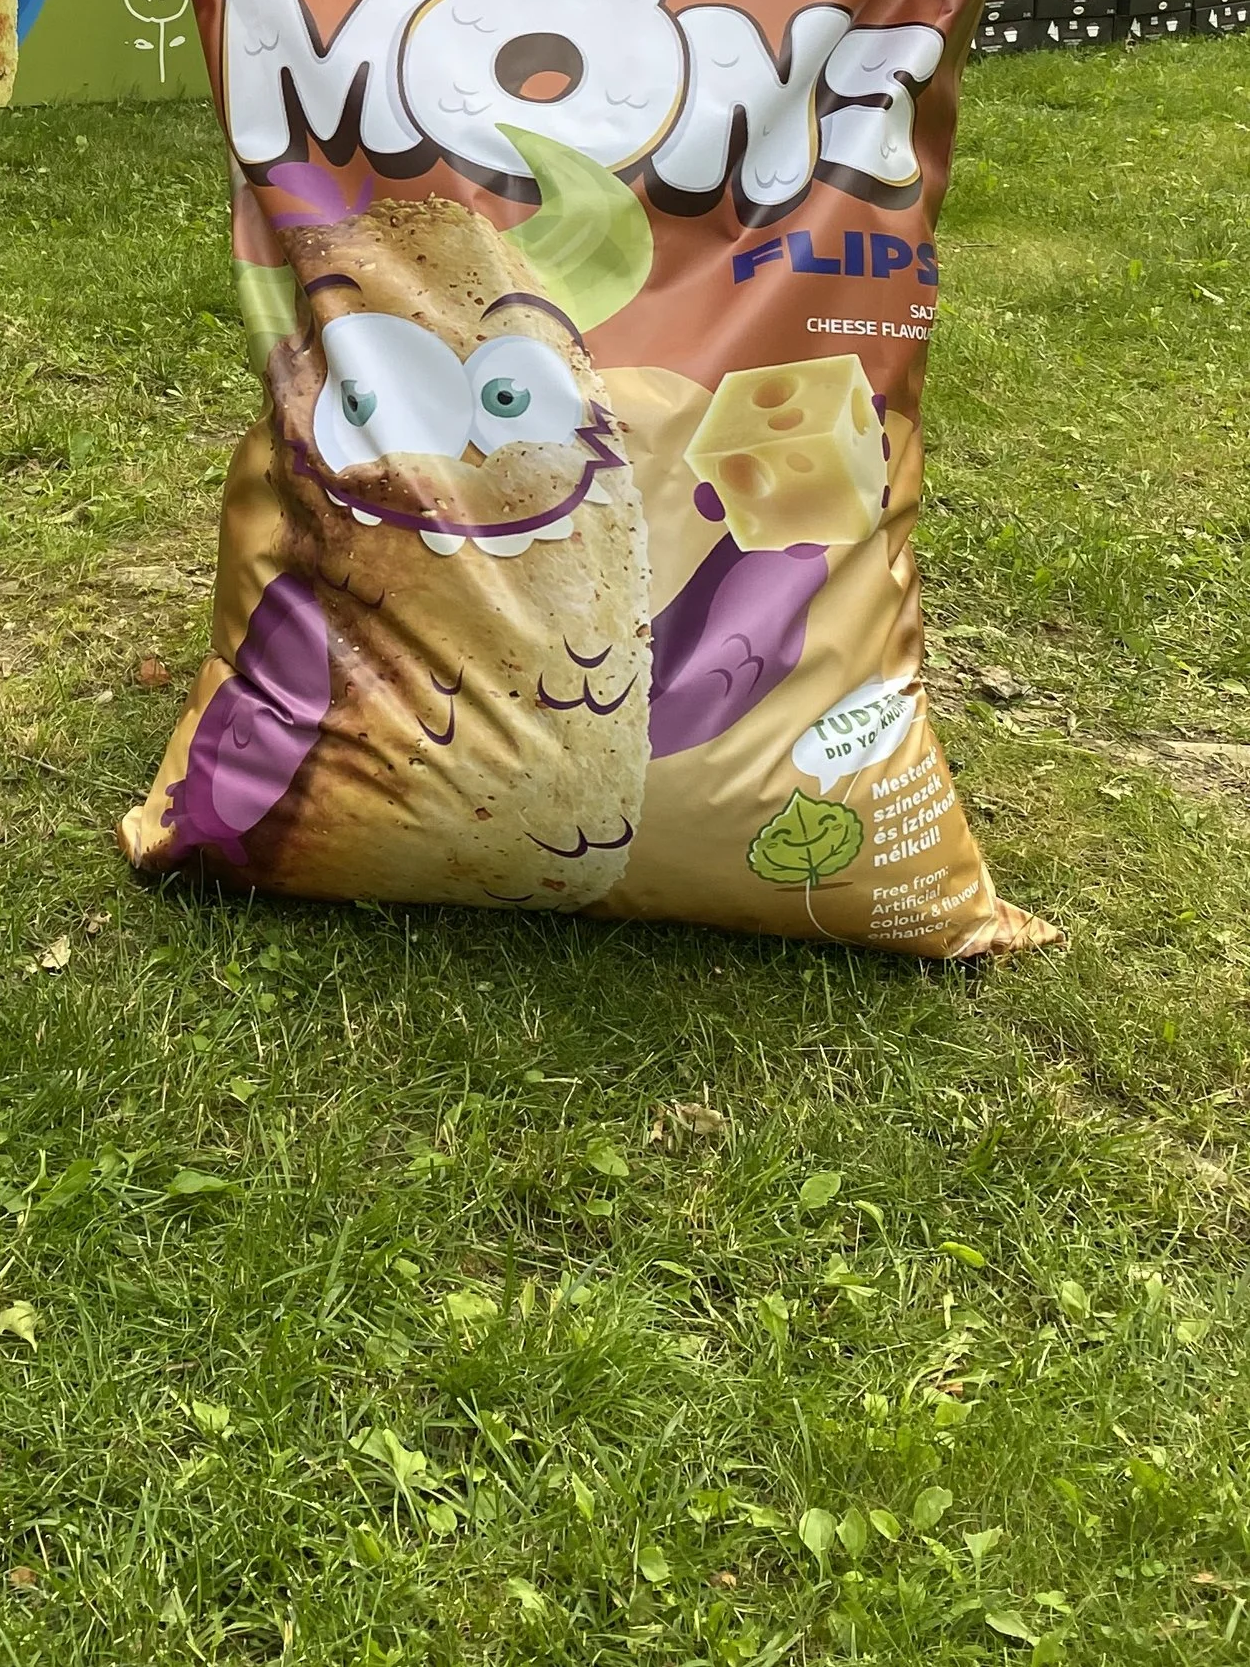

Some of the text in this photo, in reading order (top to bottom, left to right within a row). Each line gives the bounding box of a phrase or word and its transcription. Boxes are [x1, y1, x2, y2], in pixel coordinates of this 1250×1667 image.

[732, 230, 939, 286] FLIPS
[806, 317, 878, 336] CHEESE
[825, 742, 852, 760] DID
[857, 727, 879, 748] YO
[873, 772, 943, 823] színezék
[873, 826, 898, 845] és
[874, 825, 941, 867] nélkül!
[871, 883, 941, 915] Artificial
[873, 865, 949, 901] Free from:
[870, 879, 980, 929] colour & flavour
[867, 918, 952, 940] enhancer
